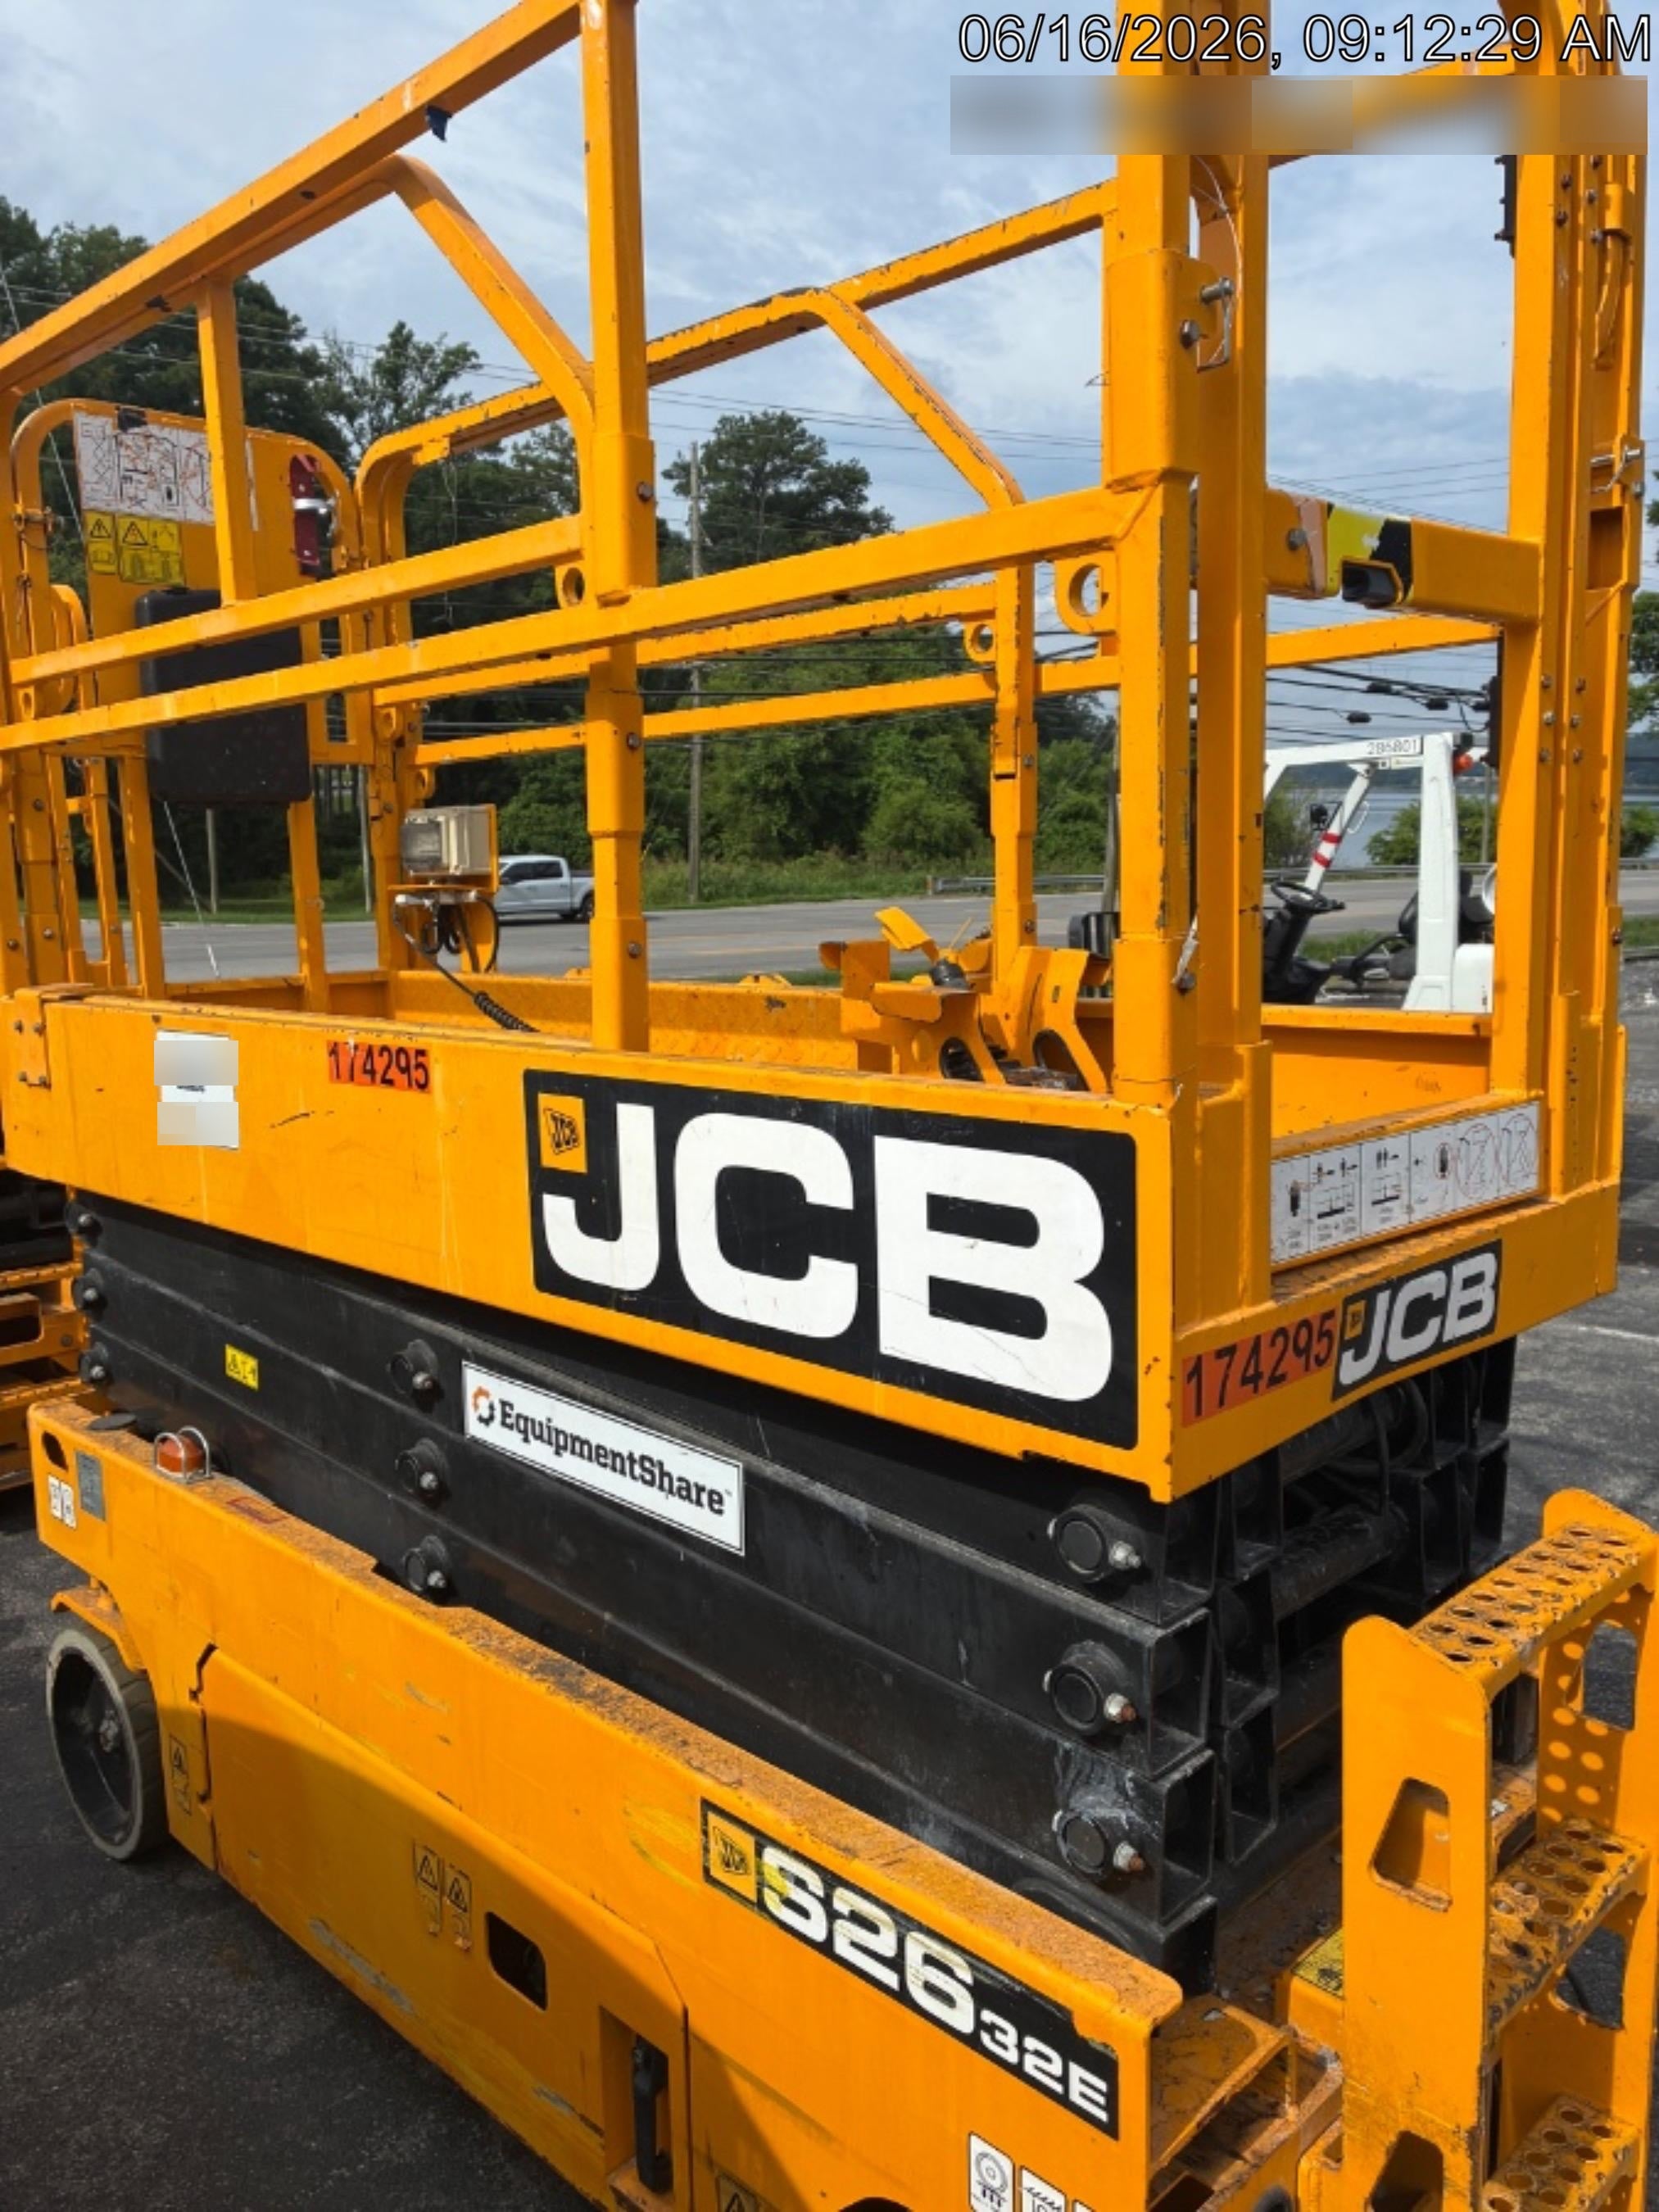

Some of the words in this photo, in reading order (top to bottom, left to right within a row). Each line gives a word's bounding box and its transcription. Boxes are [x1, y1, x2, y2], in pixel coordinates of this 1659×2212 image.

[329, 1041, 430, 1090] 174295
[542, 1101, 1113, 1403] JCB
[1186, 1312, 1335, 1416] 174295
[1338, 1252, 1498, 1385] JCB
[498, 1398, 726, 1516] EquipmentShare
